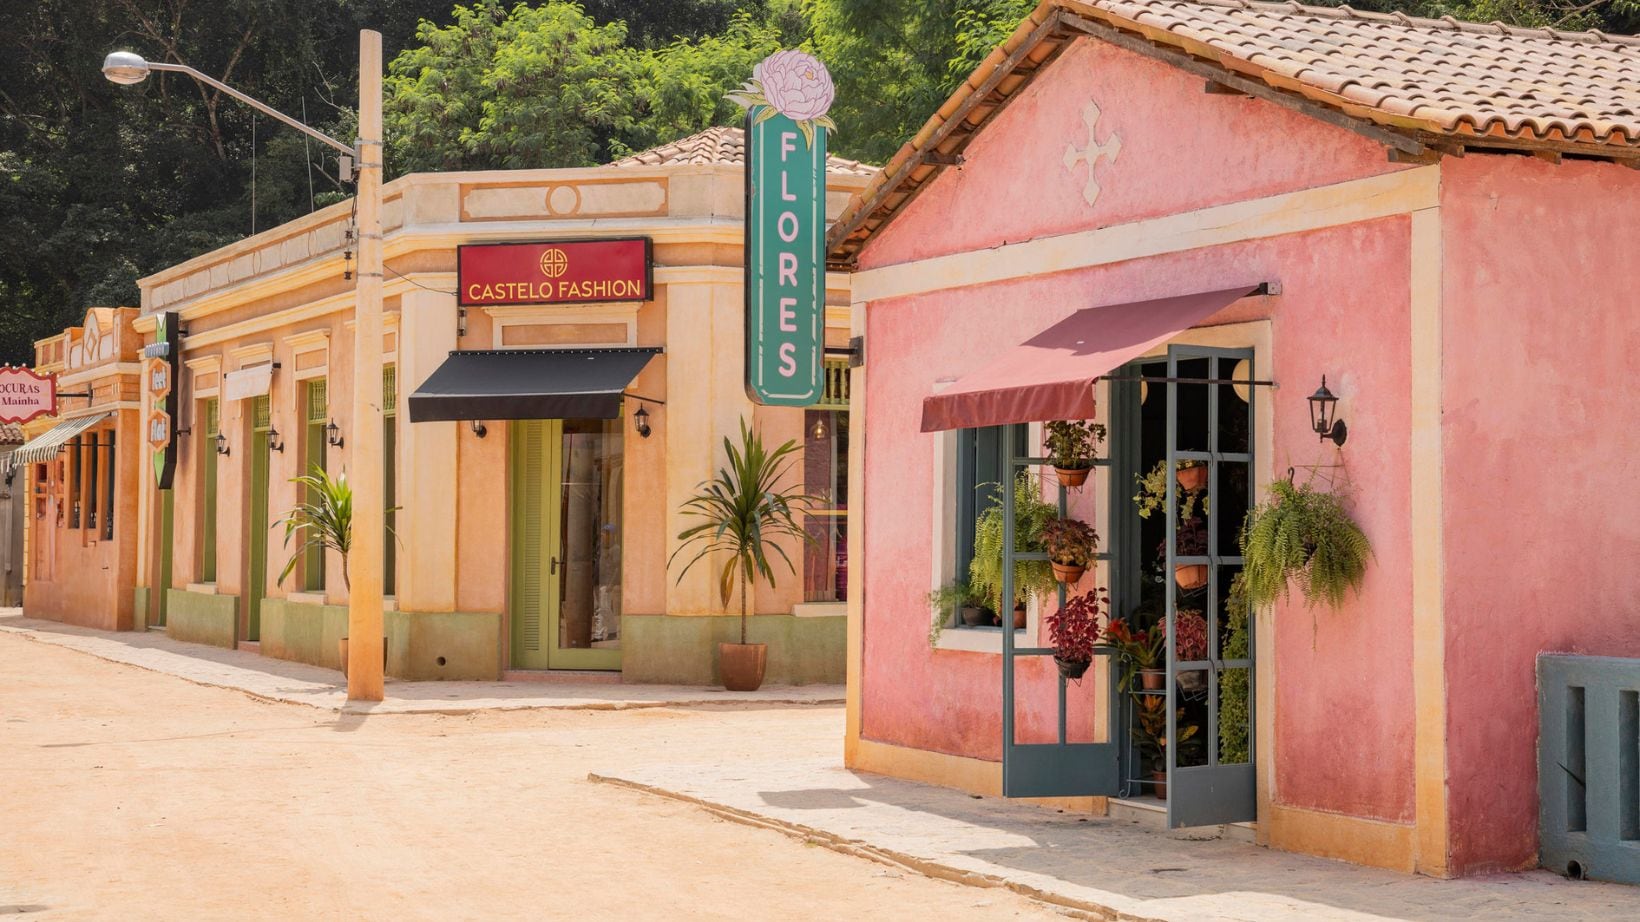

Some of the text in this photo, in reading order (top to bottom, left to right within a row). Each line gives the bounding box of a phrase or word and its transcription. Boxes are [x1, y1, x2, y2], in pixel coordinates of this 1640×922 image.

[778, 131, 798, 378] FLORES
[468, 279, 641, 300] CASTELO FASHION
[1, 396, 40, 406] Mainha
